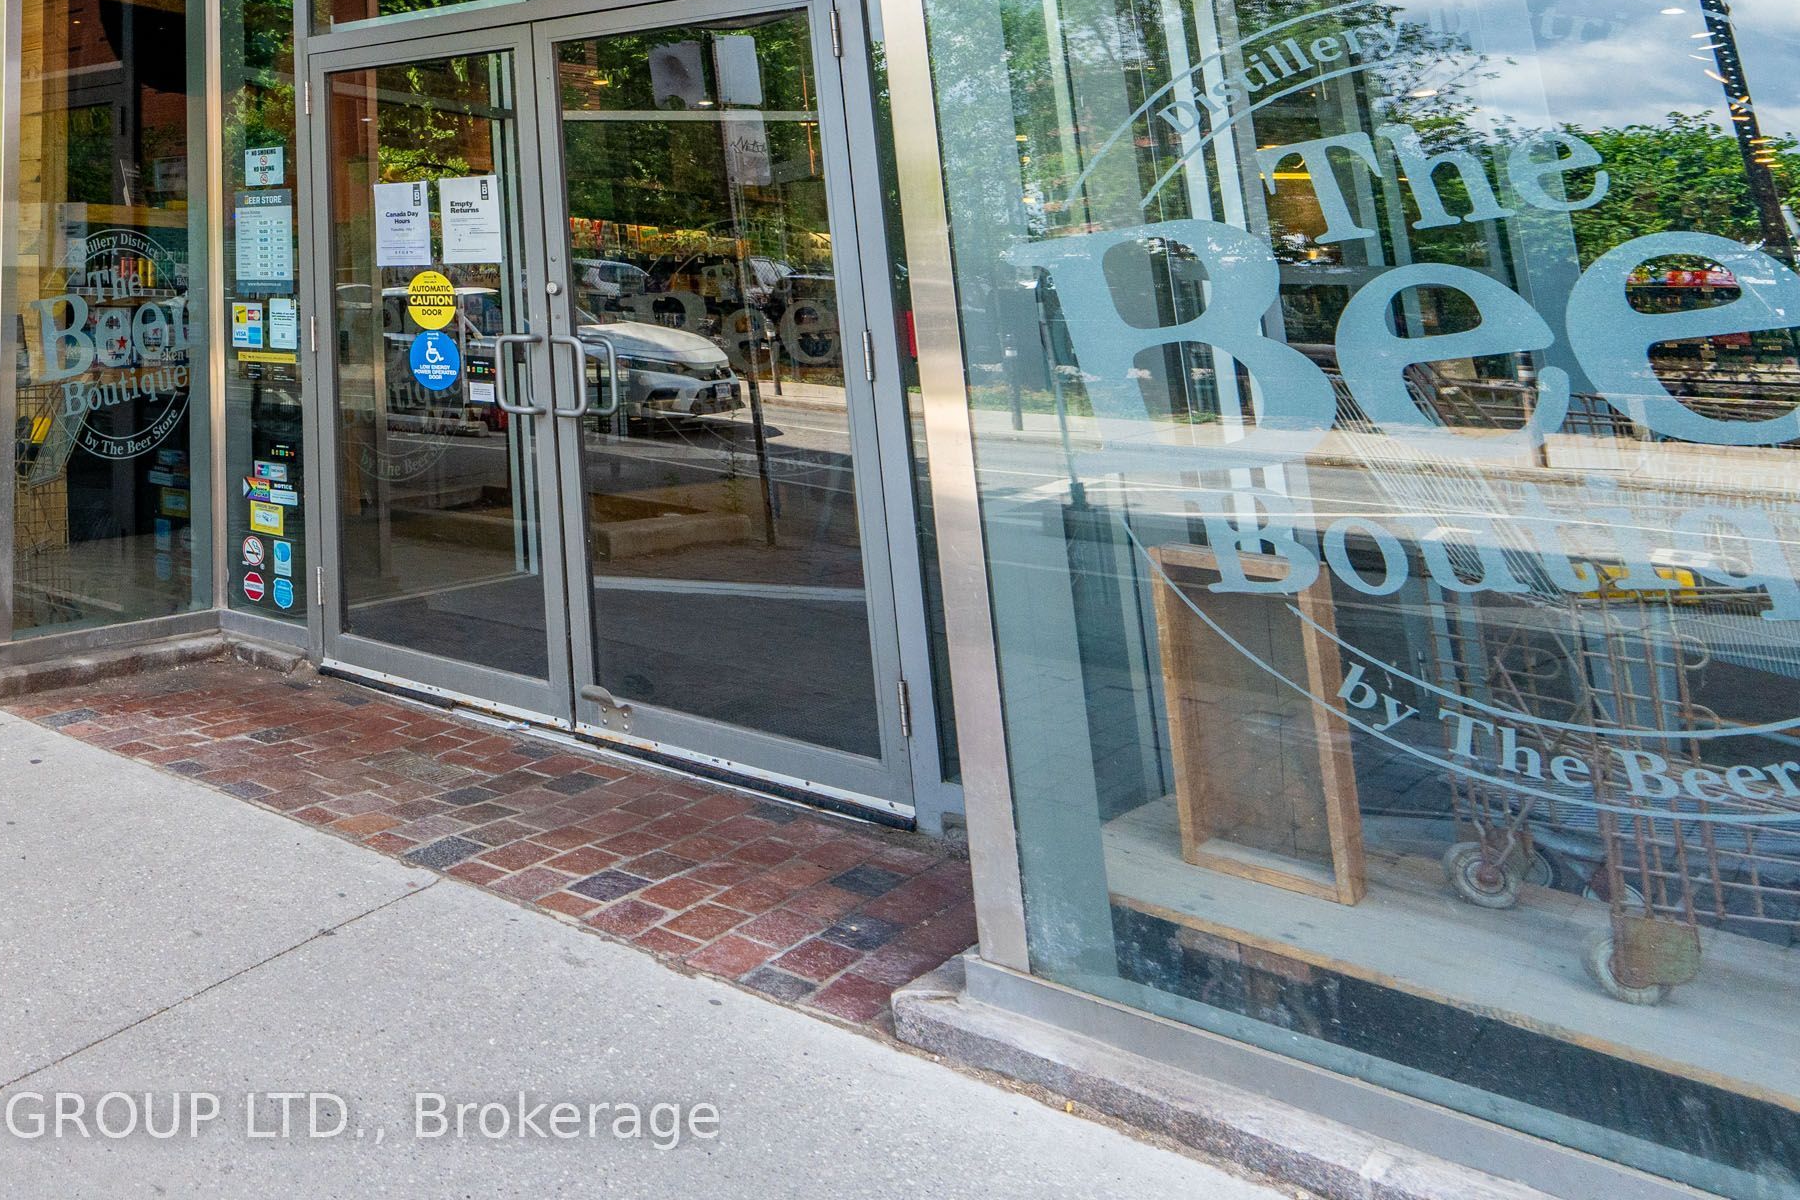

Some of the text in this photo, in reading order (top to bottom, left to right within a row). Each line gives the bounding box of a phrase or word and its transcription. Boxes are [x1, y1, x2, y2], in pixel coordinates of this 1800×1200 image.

[1156, 20, 1401, 137] Distillery
[261, 195, 282, 204] STORE
[1259, 126, 1610, 246] The
[407, 210, 419, 218] Day
[120, 233, 160, 260] District
[87, 269, 143, 305] The
[410, 295, 453, 306] CAUTION
[411, 285, 451, 293] AUTOMATIC
[421, 308, 442, 316] DOOR
[29, 293, 198, 384] Beer
[61, 363, 189, 418] Boutique
[85, 409, 178, 455] by The Beer Store
[1336, 661, 1800, 802] by The Beer
